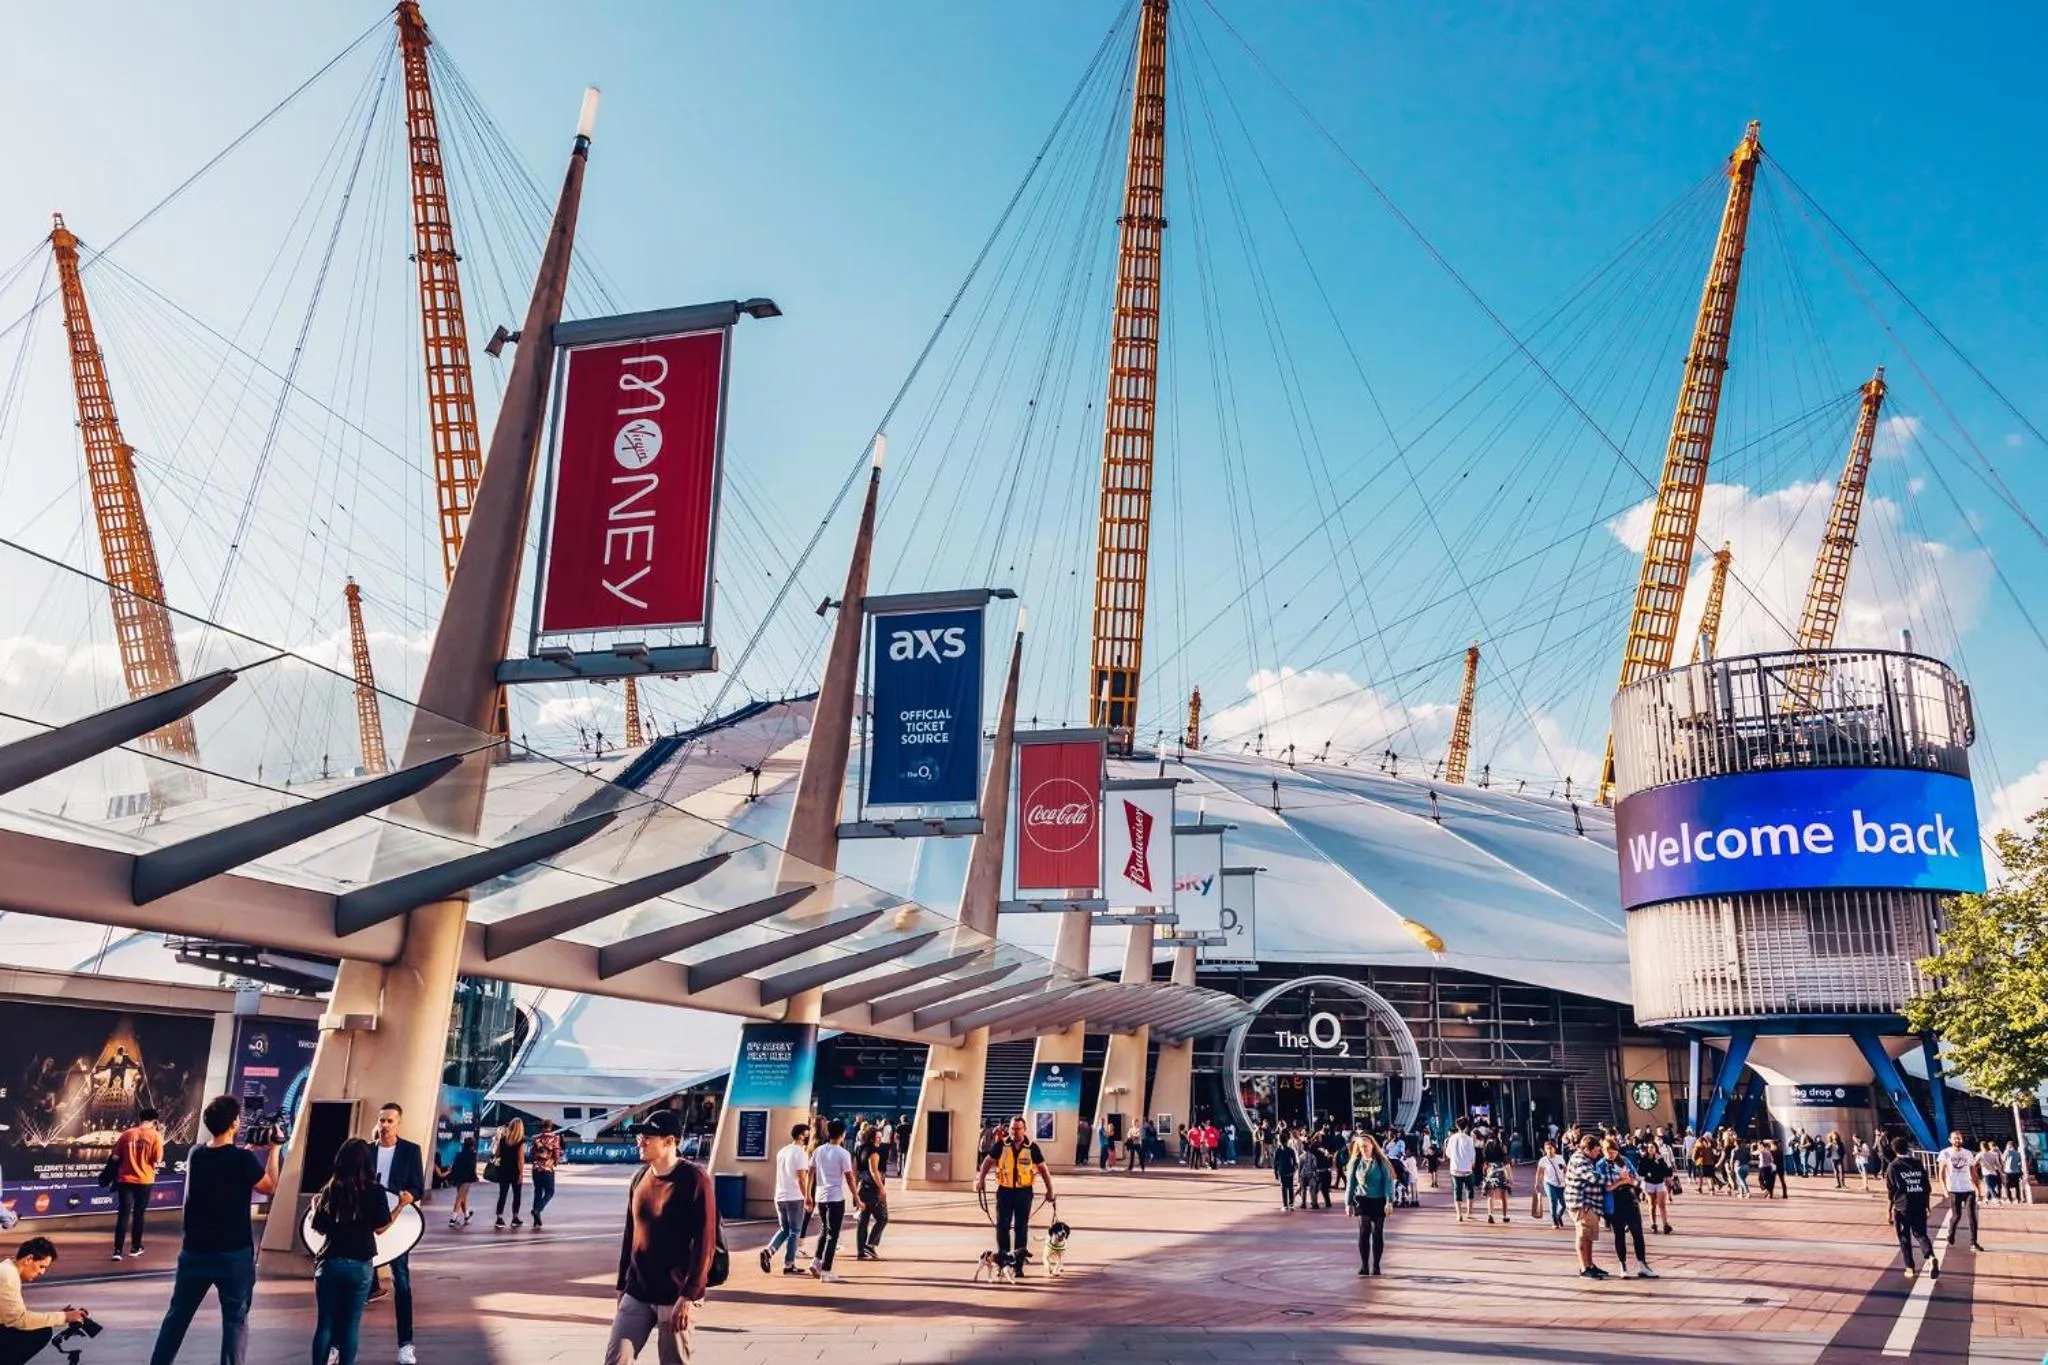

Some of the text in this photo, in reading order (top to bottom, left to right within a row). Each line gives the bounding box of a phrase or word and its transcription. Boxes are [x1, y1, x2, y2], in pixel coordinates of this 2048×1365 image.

[900, 709, 952, 721] OFFICIAL
[906, 721, 945, 732] TICKET
[901, 733, 949, 744] SOURCE
[1131, 807, 1146, 885] Budweiser
[1628, 809, 1958, 873] Welcome back
[1275, 1031, 1309, 1048] The
[1809, 1088, 1832, 1098] drop
